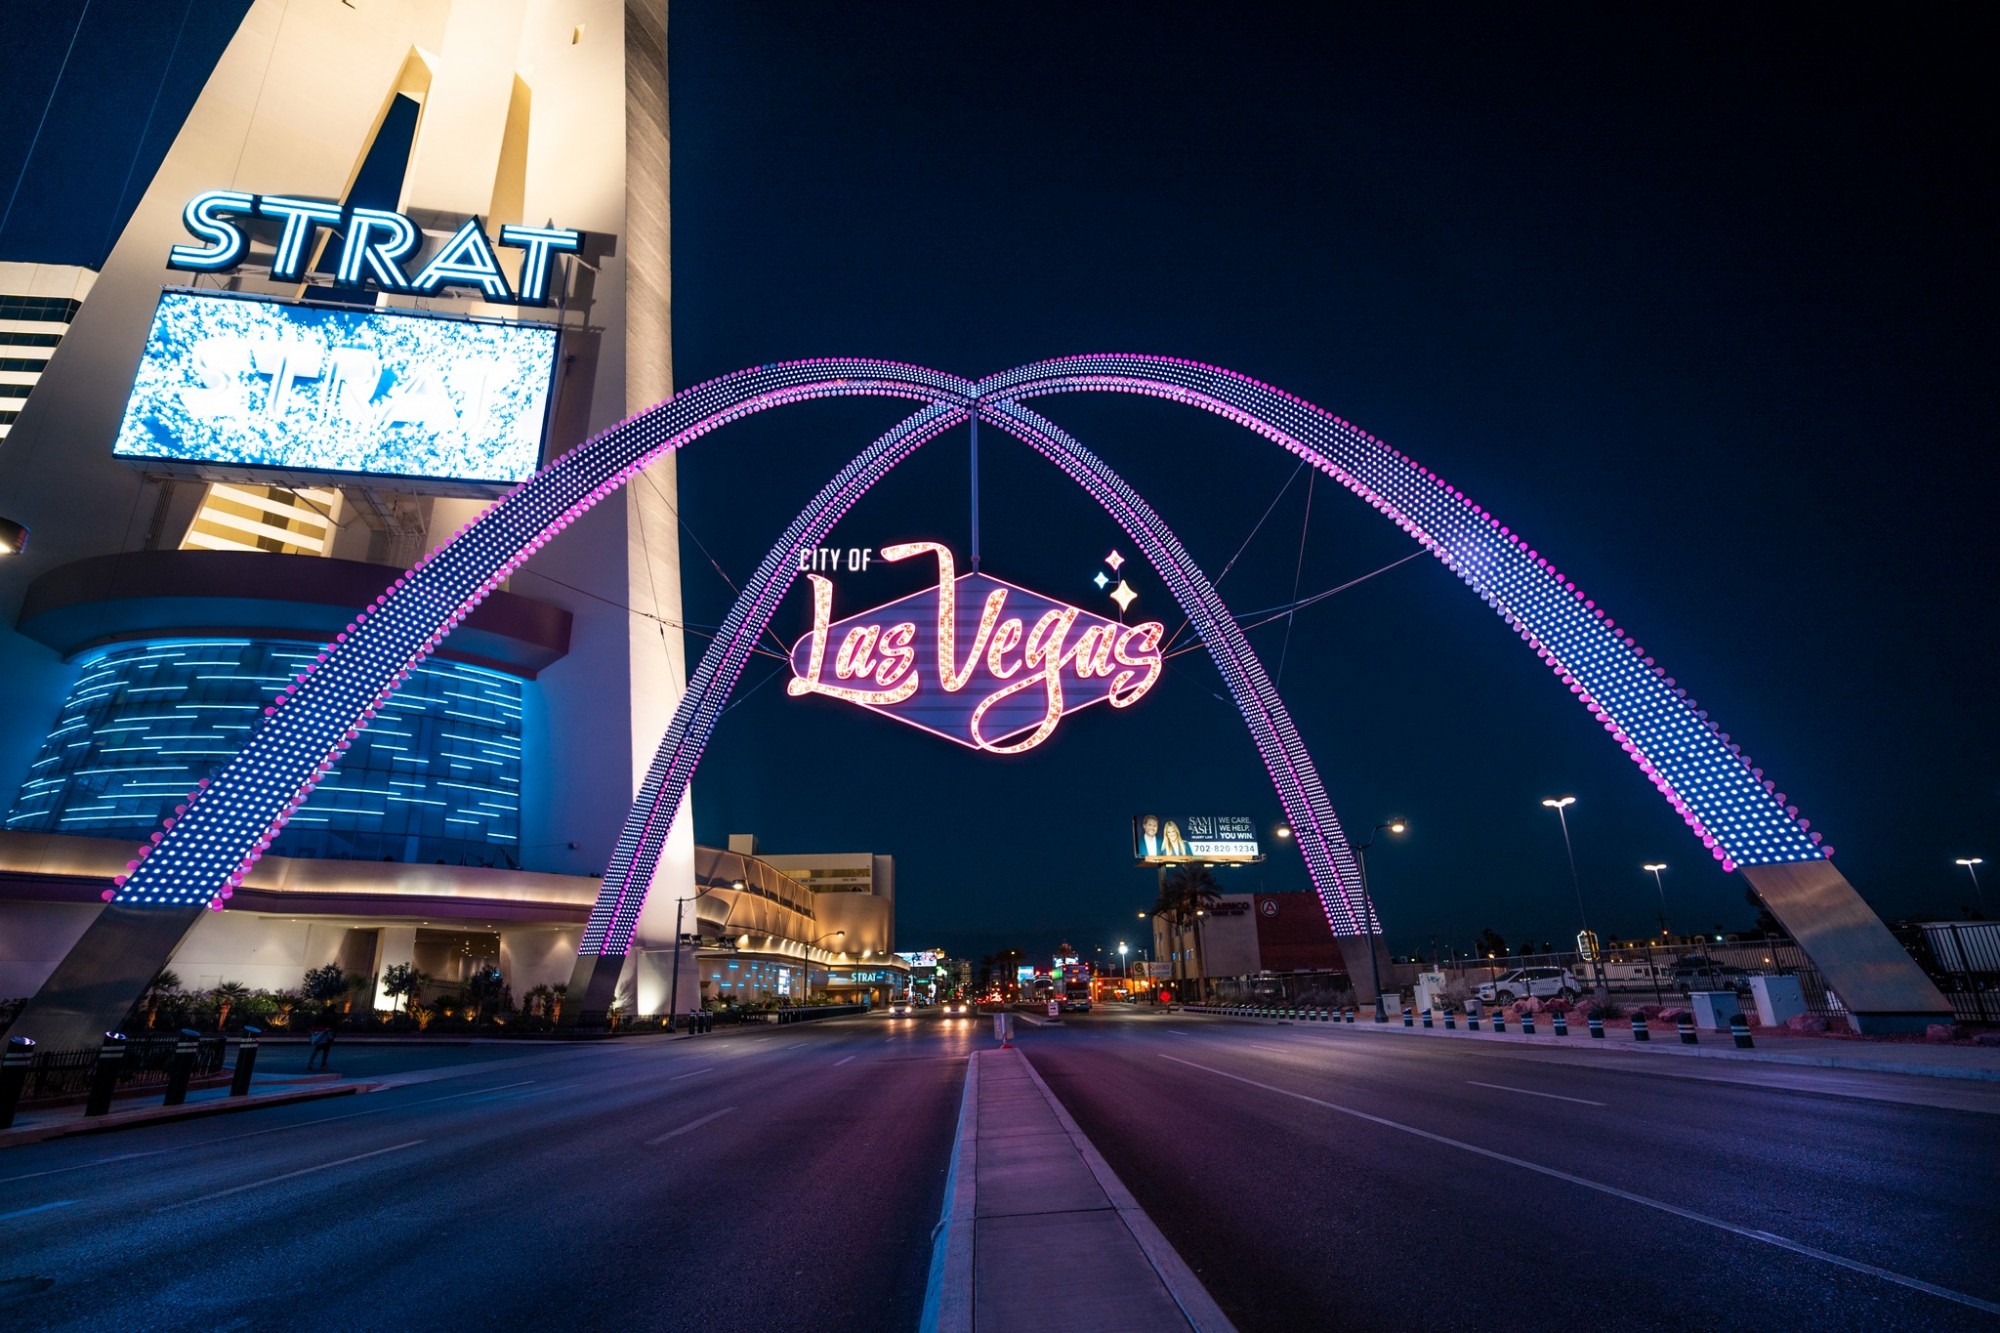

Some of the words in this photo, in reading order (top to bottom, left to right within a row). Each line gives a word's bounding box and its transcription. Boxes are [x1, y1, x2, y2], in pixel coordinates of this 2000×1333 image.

[166, 189, 585, 306] STRAT
[182, 337, 512, 432] STRAT
[800, 548, 840, 571] CITY
[848, 548, 872, 571] OF
[787, 573, 918, 705] Las
[880, 542, 1163, 754] Vegas
[1188, 817, 1211, 825] SAM
[1191, 825, 1213, 834] ASH
[851, 972, 876, 982] STRAT
